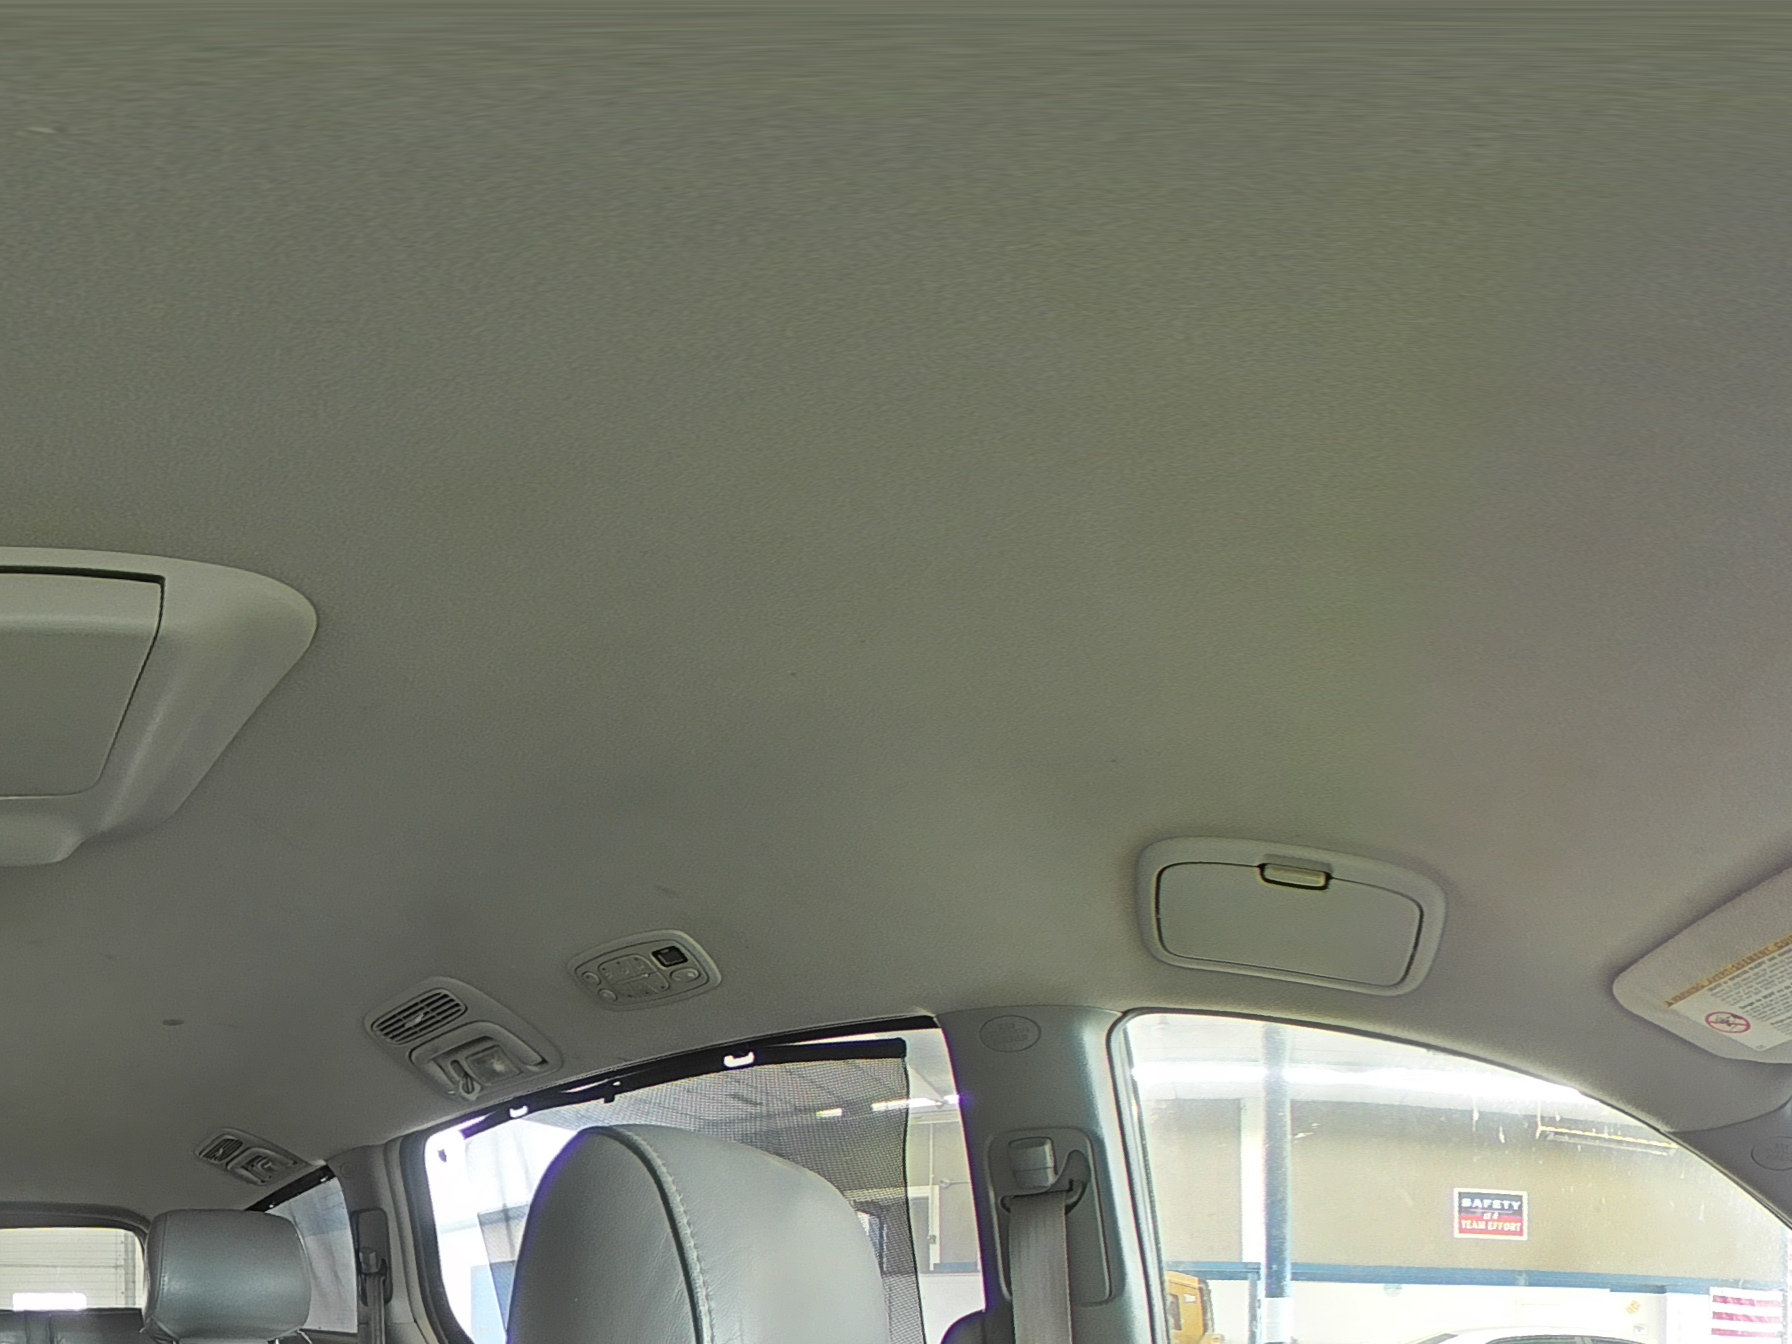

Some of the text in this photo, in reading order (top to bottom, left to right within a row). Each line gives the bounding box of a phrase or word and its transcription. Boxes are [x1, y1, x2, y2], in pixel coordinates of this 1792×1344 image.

[1461, 1198, 1521, 1210] SAFETY
[1461, 1219, 1521, 1232] TEAM EFFORT
